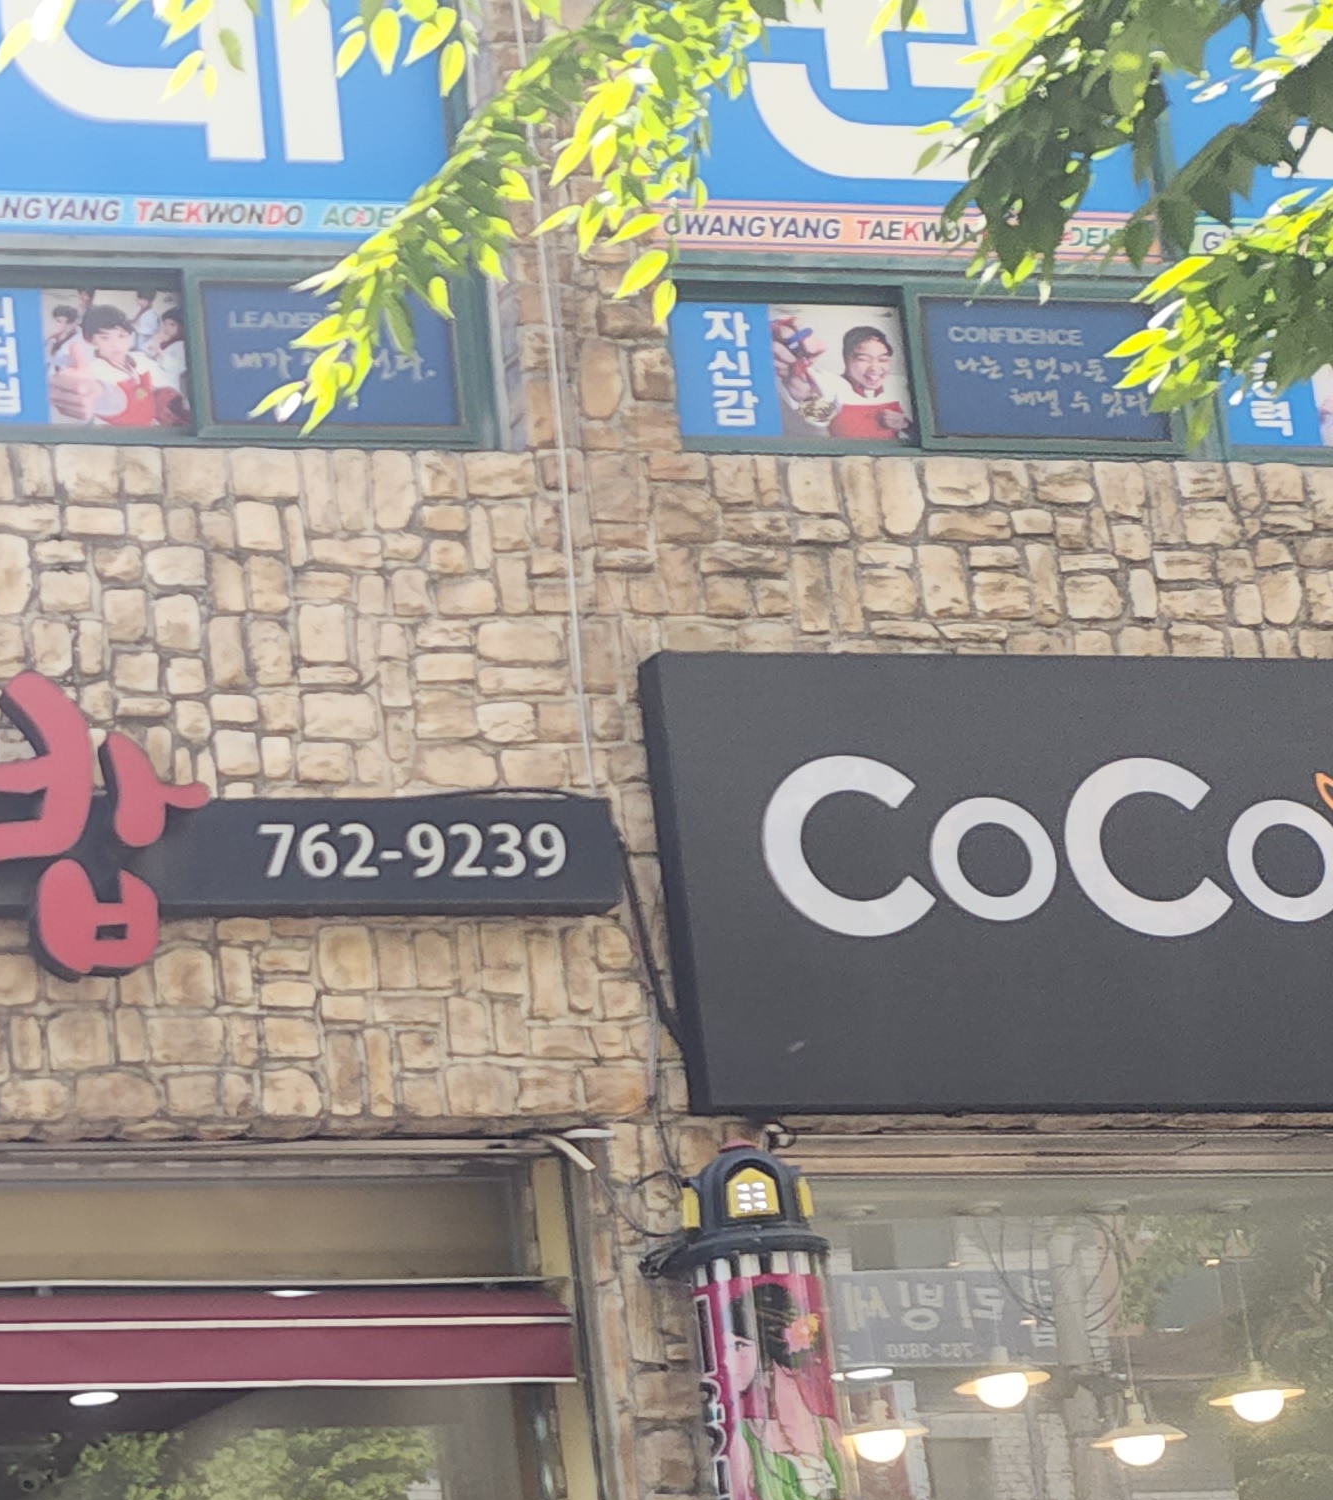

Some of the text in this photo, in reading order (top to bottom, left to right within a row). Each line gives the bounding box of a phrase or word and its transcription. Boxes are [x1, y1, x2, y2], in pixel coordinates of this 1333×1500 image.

[136, 201, 303, 226] TAEKWONDO
[663, 215, 841, 240] GWANGYANG
[948, 326, 1084, 346] CONFIDENCE
[703, 309, 758, 428] 자신감
[954, 354, 1108, 383] 나는 무엇이든
[1069, 390, 1091, 414] 수
[258, 822, 568, 880] 762-9239
